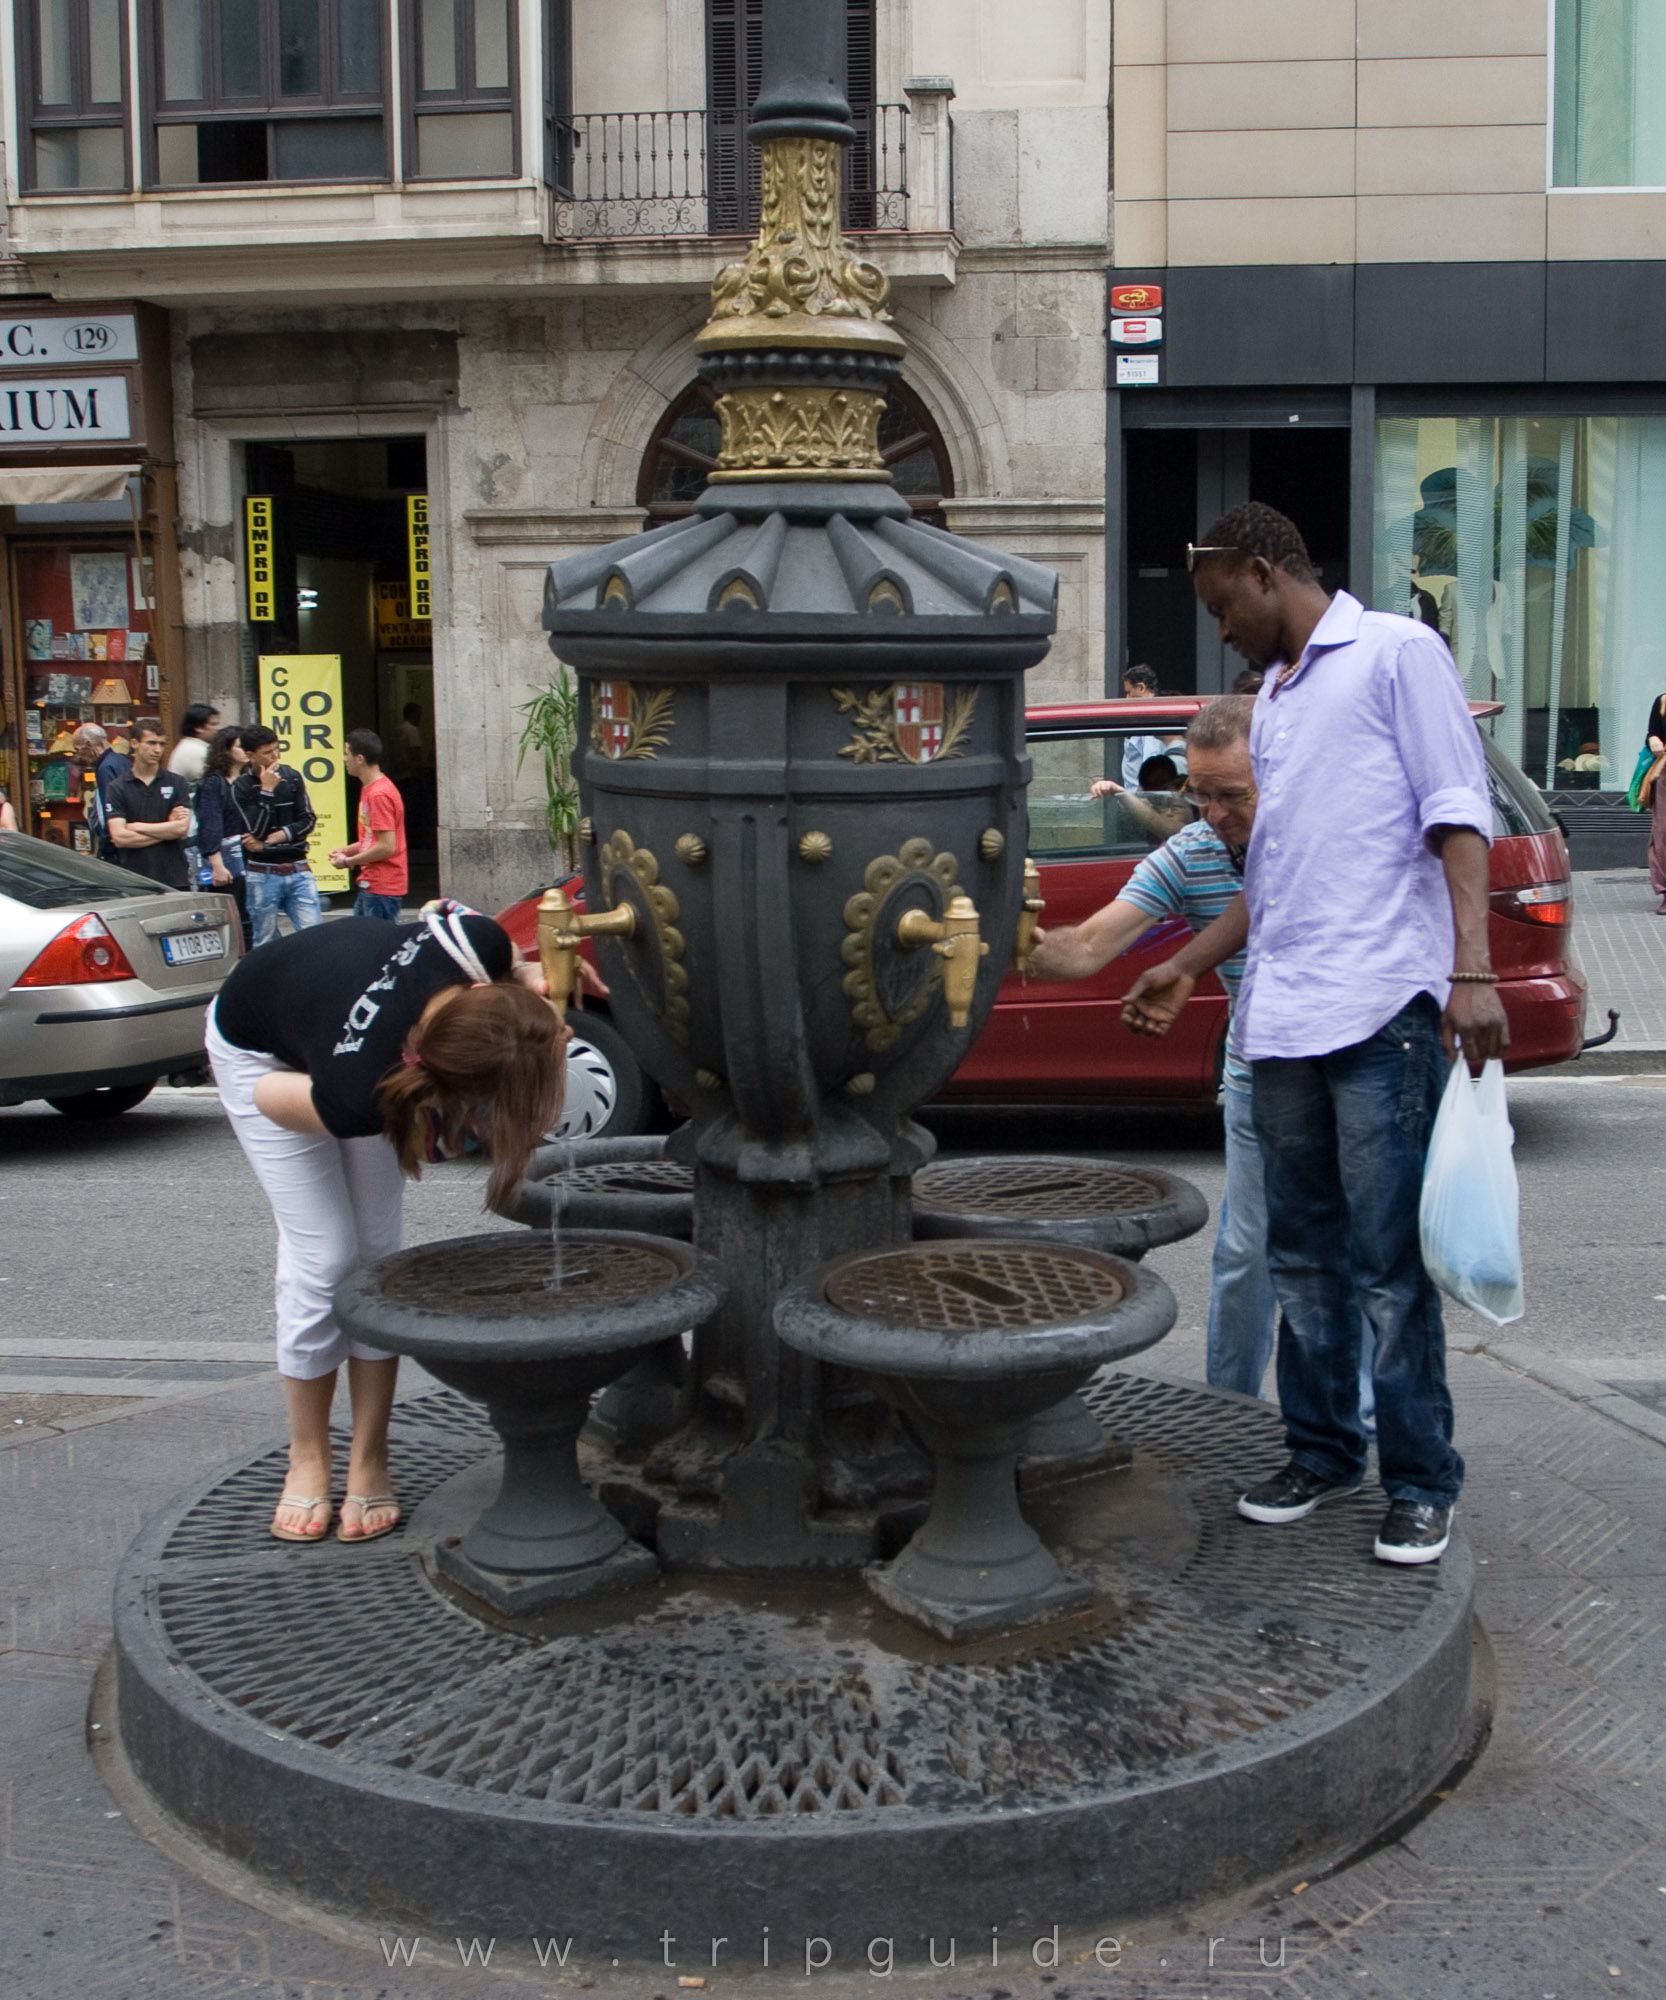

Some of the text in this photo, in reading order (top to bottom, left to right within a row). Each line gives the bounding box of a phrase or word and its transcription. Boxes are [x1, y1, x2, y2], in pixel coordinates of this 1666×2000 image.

[73, 327, 108, 350] 129
[0, 388, 102, 431] IUM
[252, 502, 269, 617] COMPRO OR
[413, 499, 430, 616] COMPRO ORO
[299, 691, 335, 783] ORO
